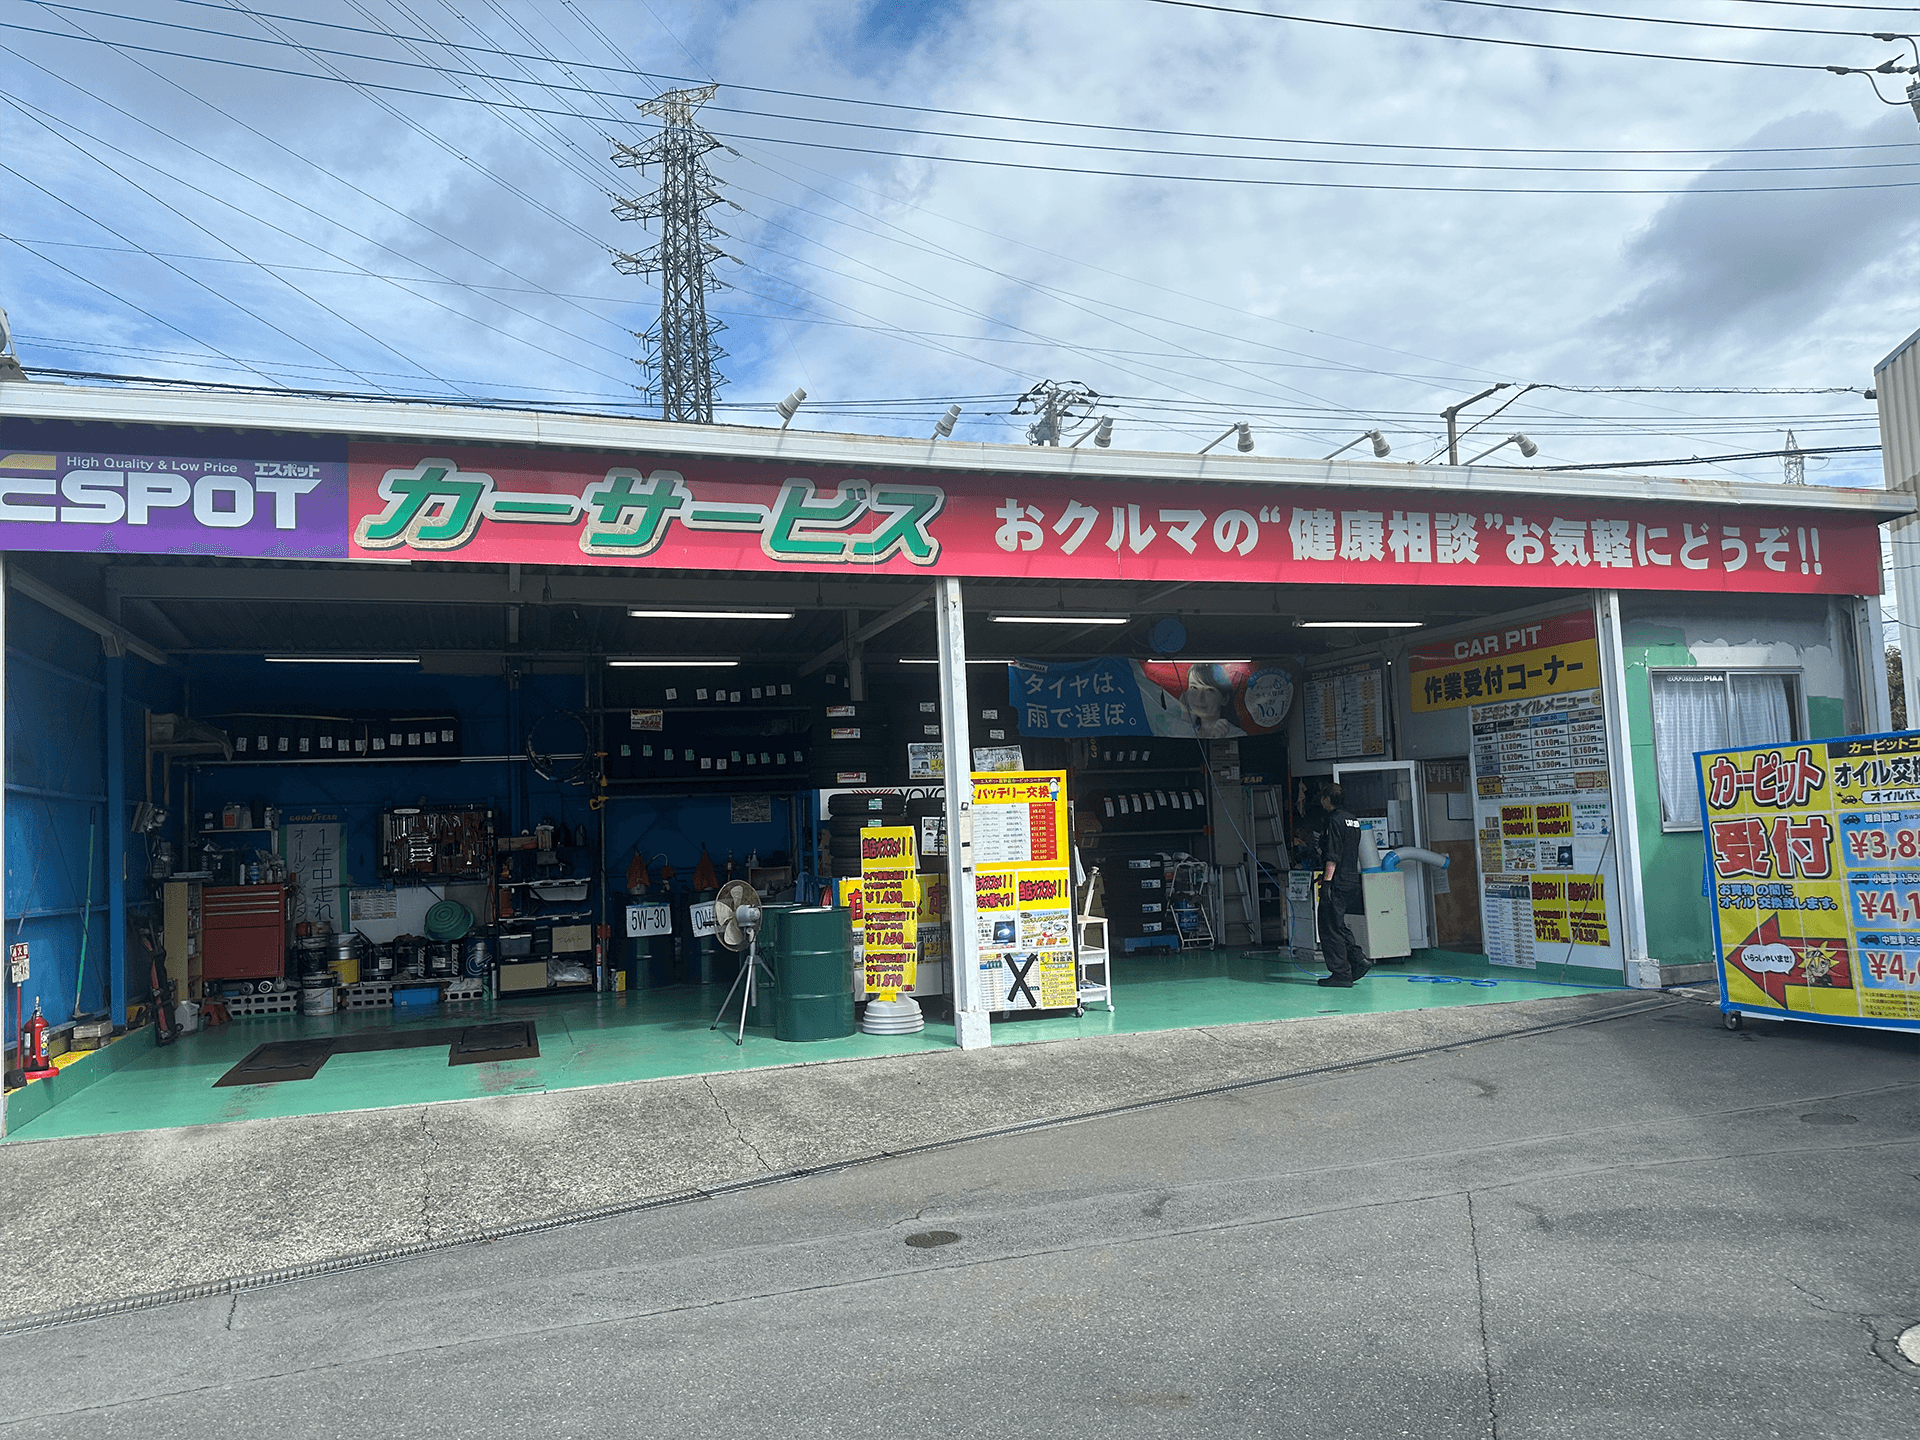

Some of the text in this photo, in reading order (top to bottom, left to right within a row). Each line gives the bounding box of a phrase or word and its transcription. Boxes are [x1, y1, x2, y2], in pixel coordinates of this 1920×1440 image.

[66, 456, 238, 473] High Quality & Low Price
[254, 462, 320, 478] エスポット
[0, 454, 321, 530] ESPOT
[354, 458, 944, 566] カーサービス
[1454, 625, 1542, 659] CAR PIT
[1024, 672, 1125, 699] タイヤは、
[1424, 655, 1584, 704] 作業受付コーナー
[1026, 702, 1137, 729] 雨で選ぼ。
[1511, 696, 1590, 716] オイルメニュー
[977, 785, 1050, 800] バッテリー交換
[1709, 747, 1825, 810] カーピット
[1711, 816, 1834, 878] 受付
[631, 908, 667, 932] 5W-30
[1866, 952, 1920, 985] ¥4,
